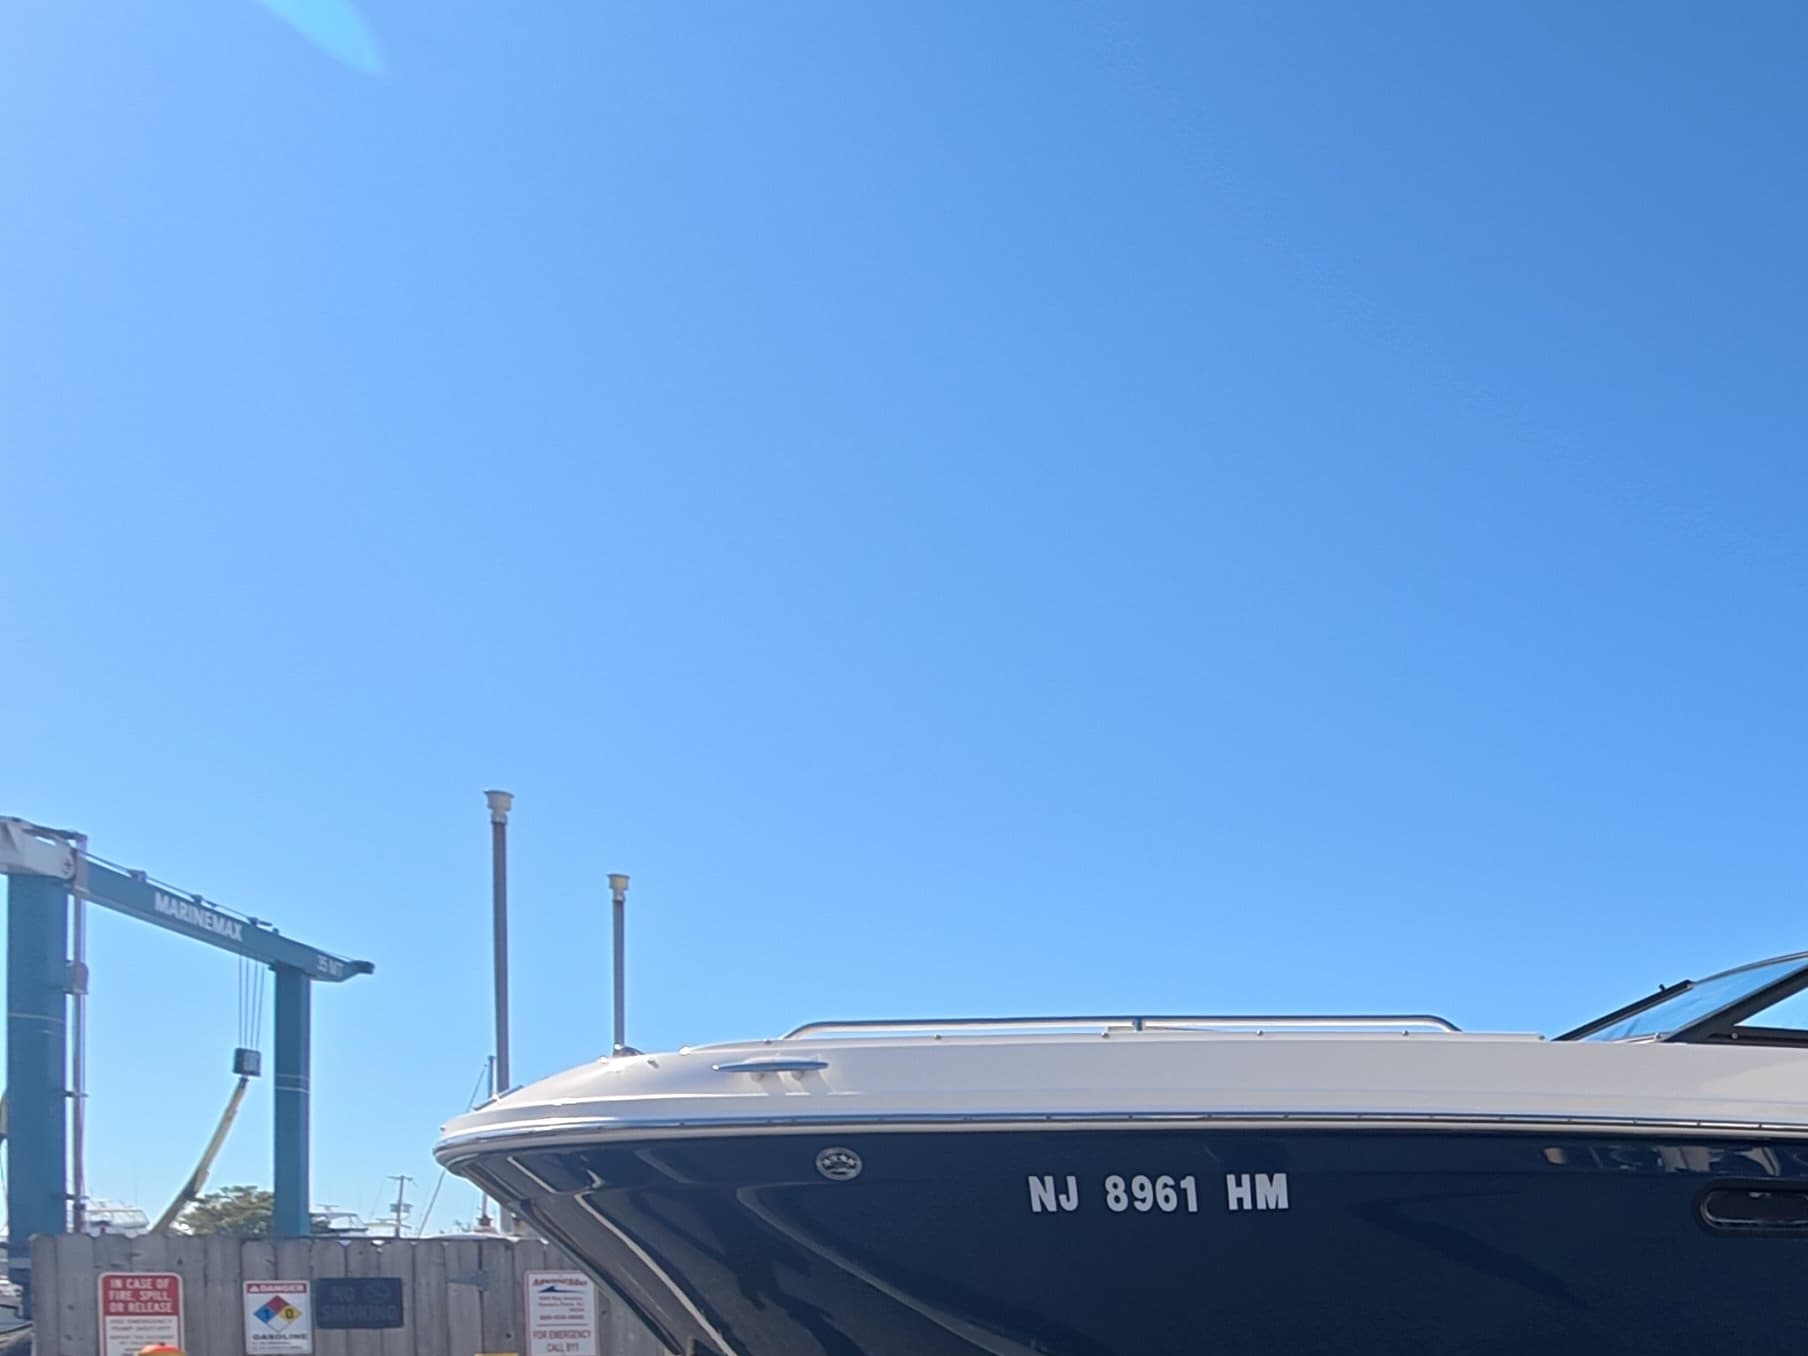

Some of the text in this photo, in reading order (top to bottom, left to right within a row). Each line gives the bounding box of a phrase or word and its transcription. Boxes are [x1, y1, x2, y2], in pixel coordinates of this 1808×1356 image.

[154, 891, 243, 942] MARINEMAX
[1028, 1173, 1289, 1212] NJ 8961 HM
[109, 1278, 170, 1289] IN CASE OF
[331, 1286, 356, 1301] NO
[109, 1302, 173, 1313] OR RELEASE
[320, 1304, 397, 1321] SMOKING
[285, 1309, 294, 1319] 0
[533, 1330, 592, 1339] FOR EMERGENCY
[547, 1343, 579, 1353] CALL 911
